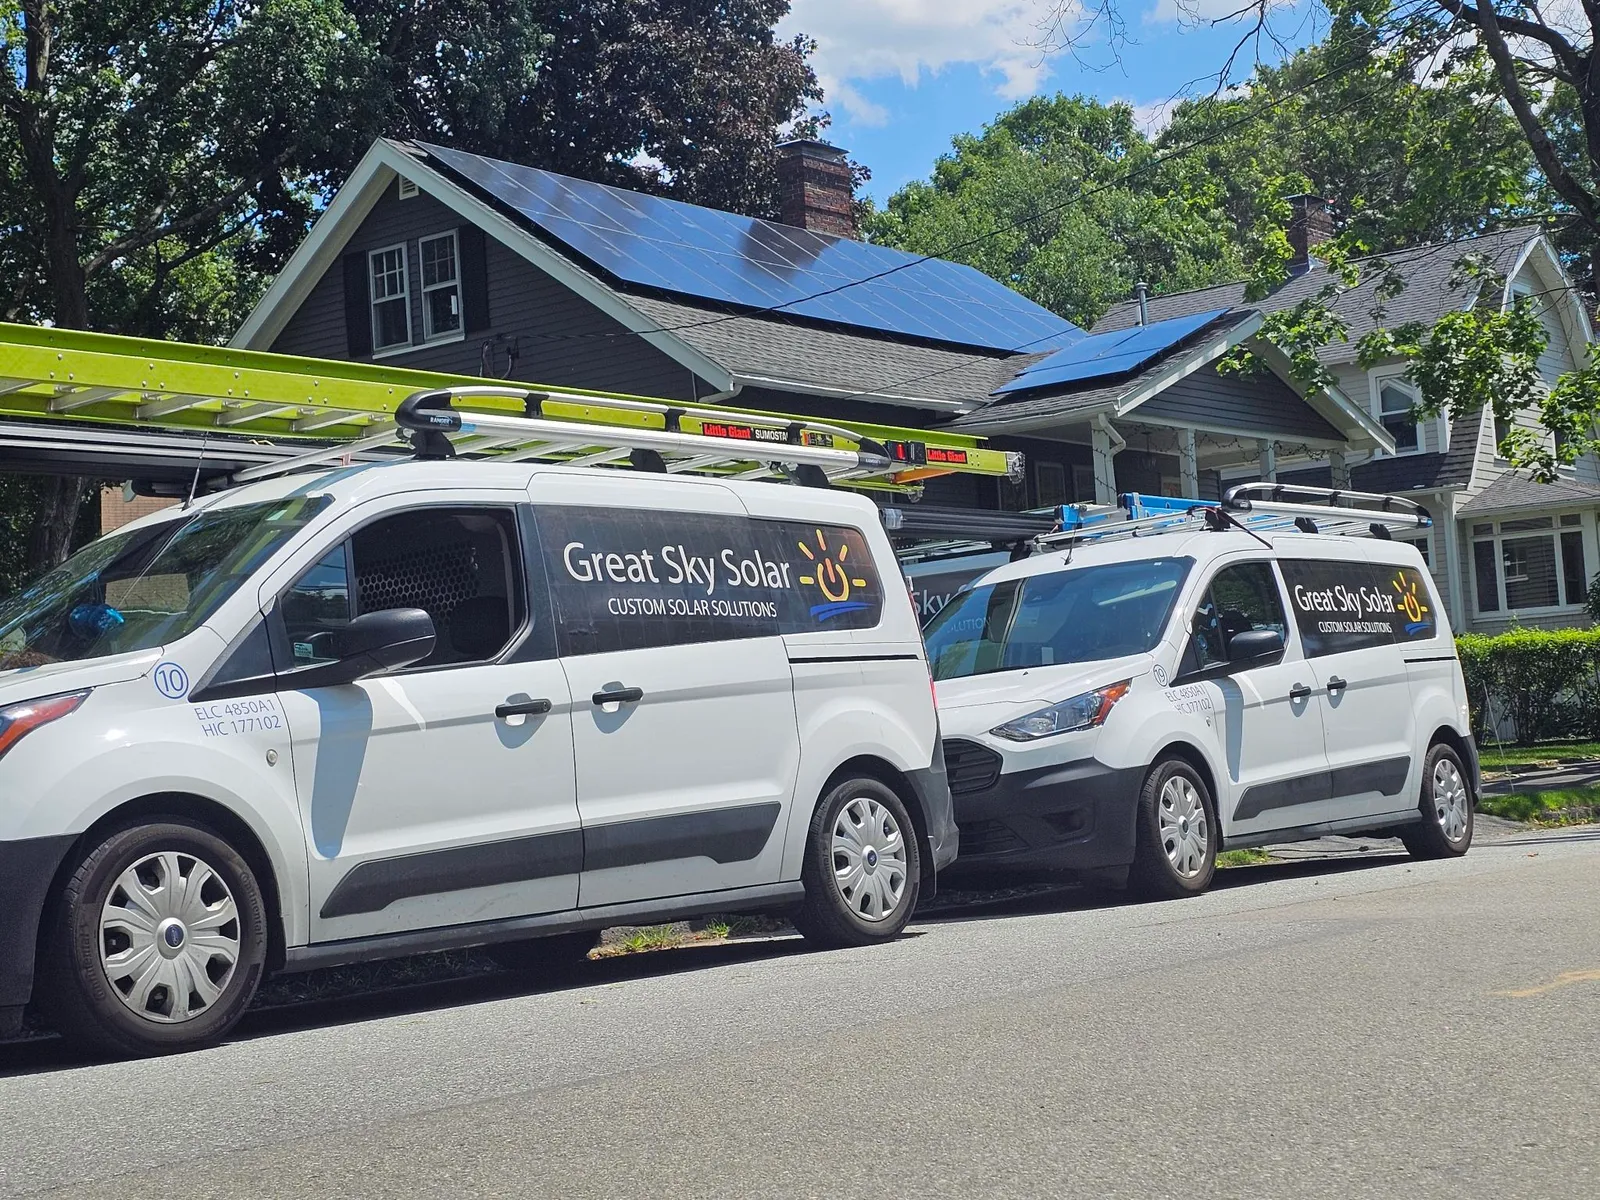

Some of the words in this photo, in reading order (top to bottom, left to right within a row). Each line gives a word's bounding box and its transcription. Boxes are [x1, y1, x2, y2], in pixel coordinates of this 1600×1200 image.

[703, 423, 727, 437] Little
[728, 425, 752, 440] Giant
[927, 449, 946, 462] Little
[947, 451, 966, 464] Giant
[563, 541, 659, 583] Great
[661, 544, 716, 595] Sky
[721, 549, 791, 589] Solar
[607, 597, 666, 616] CUSTOM
[668, 599, 710, 616] SOLAR
[711, 601, 777, 619] SOLUTIONS
[1294, 584, 1338, 613] Great
[1335, 584, 1362, 619] Sky
[1360, 586, 1396, 614] Solar
[1318, 621, 1344, 633] CUSTOM
[1343, 621, 1362, 634] SOLAR
[1361, 621, 1393, 634] SOLUTIONS
[158, 668, 184, 693] 10
[193, 705, 223, 721] ELC
[225, 699, 276, 717] 4850A1
[201, 721, 229, 737] HIC
[231, 715, 282, 734] 177102
